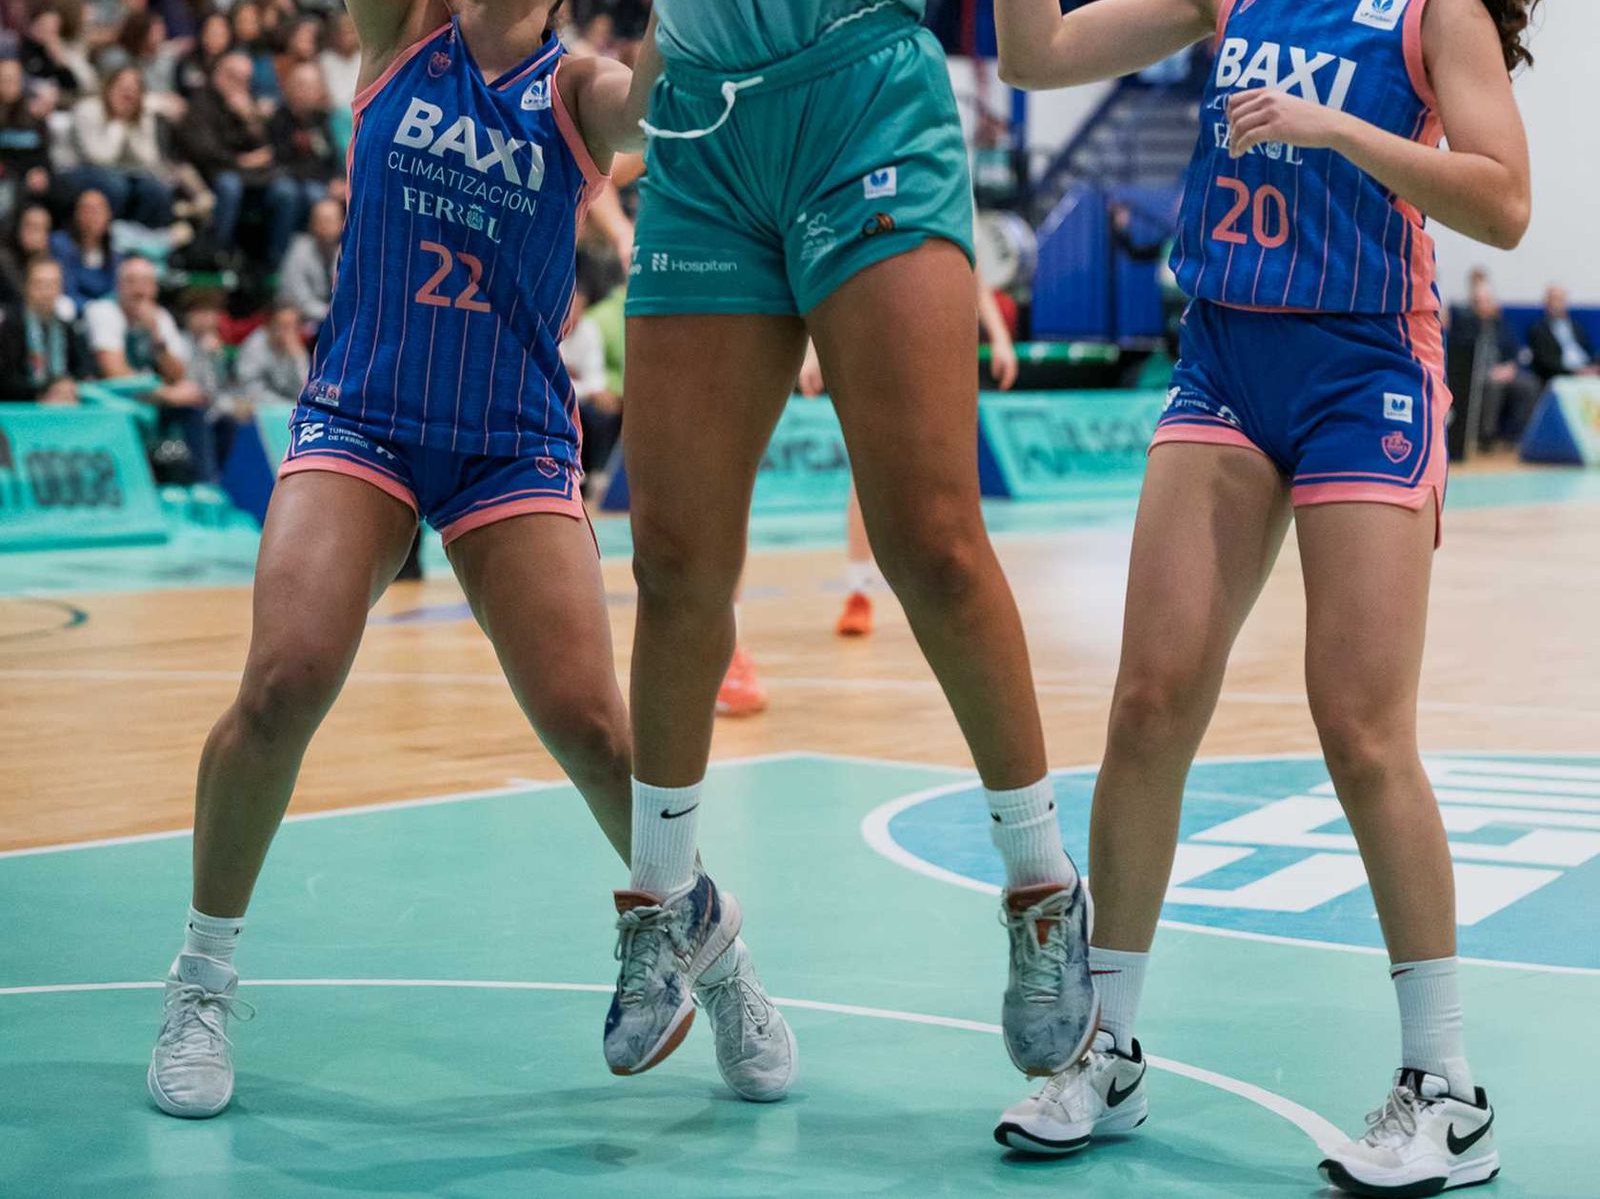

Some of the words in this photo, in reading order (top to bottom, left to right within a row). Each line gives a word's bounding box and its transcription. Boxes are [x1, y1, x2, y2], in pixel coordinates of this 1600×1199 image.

[1215, 37, 1358, 113] BAXI
[393, 96, 545, 192] BAXI
[387, 150, 537, 217] CLIMATIZACIÓN
[1211, 175, 1290, 249] 20
[415, 239, 492, 313] 22
[671, 259, 738, 274] Hospiten
